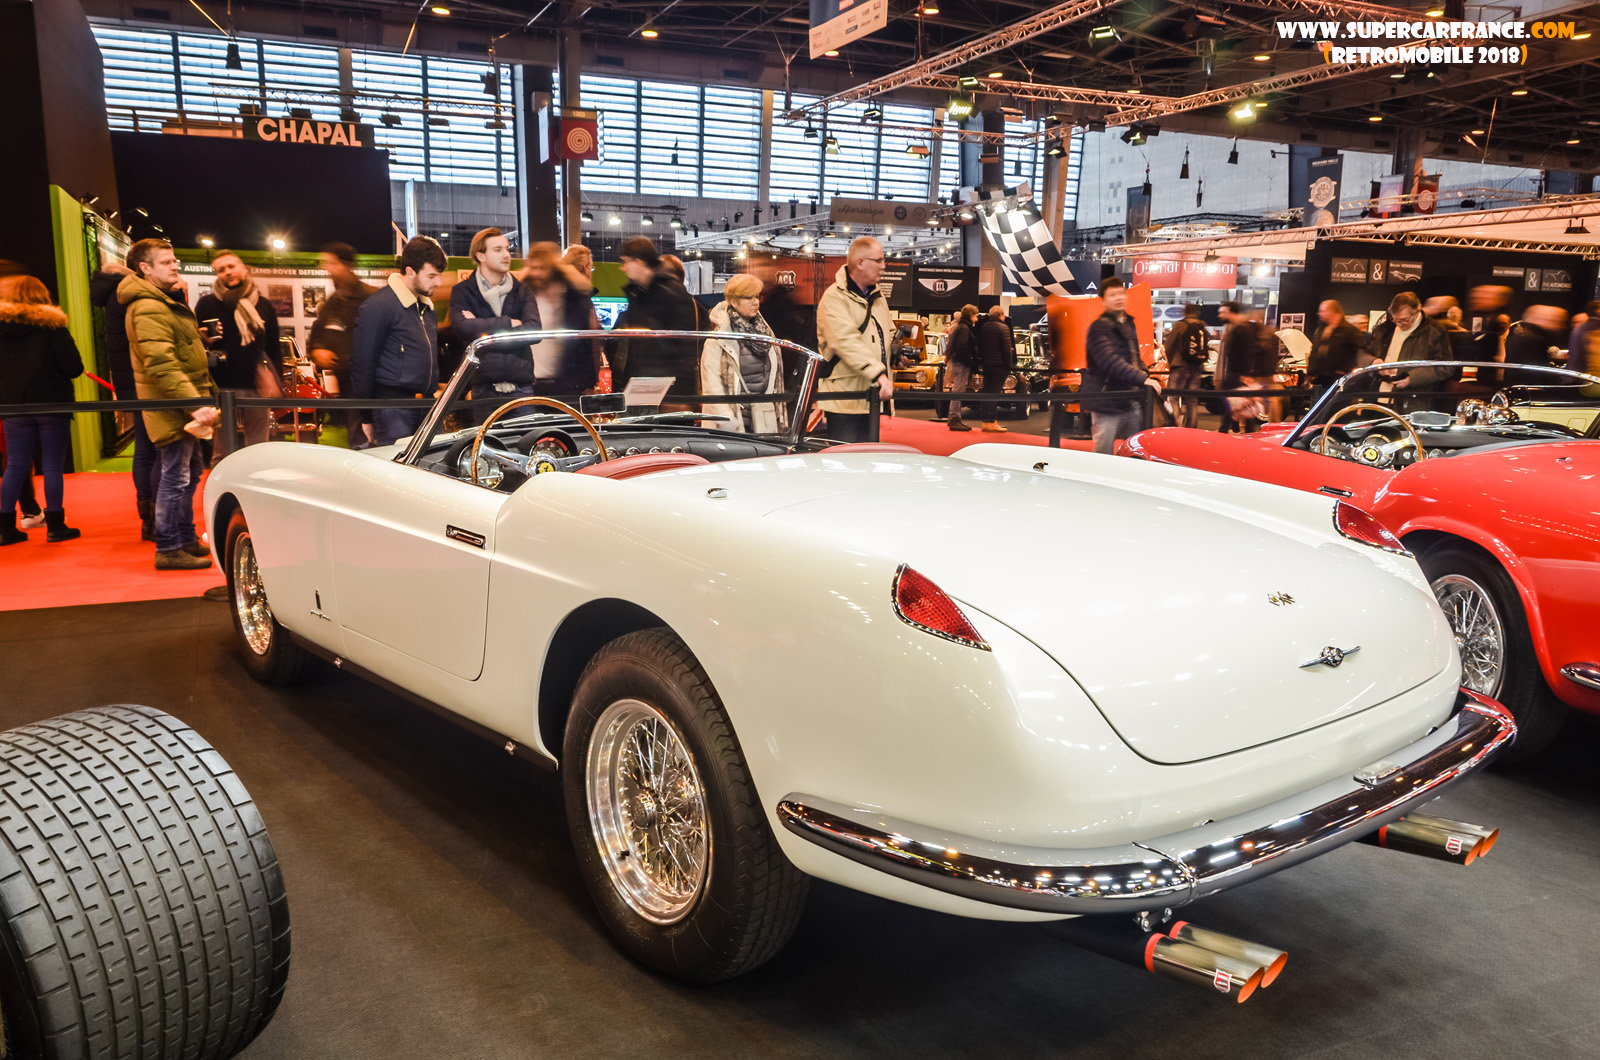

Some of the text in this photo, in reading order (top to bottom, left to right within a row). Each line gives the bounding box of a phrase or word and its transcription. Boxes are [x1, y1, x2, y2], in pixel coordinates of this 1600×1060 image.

[256, 118, 362, 147] CHAPAL
[299, 269, 331, 277] DEFENDE
[1183, 258, 1236, 275] Osat
